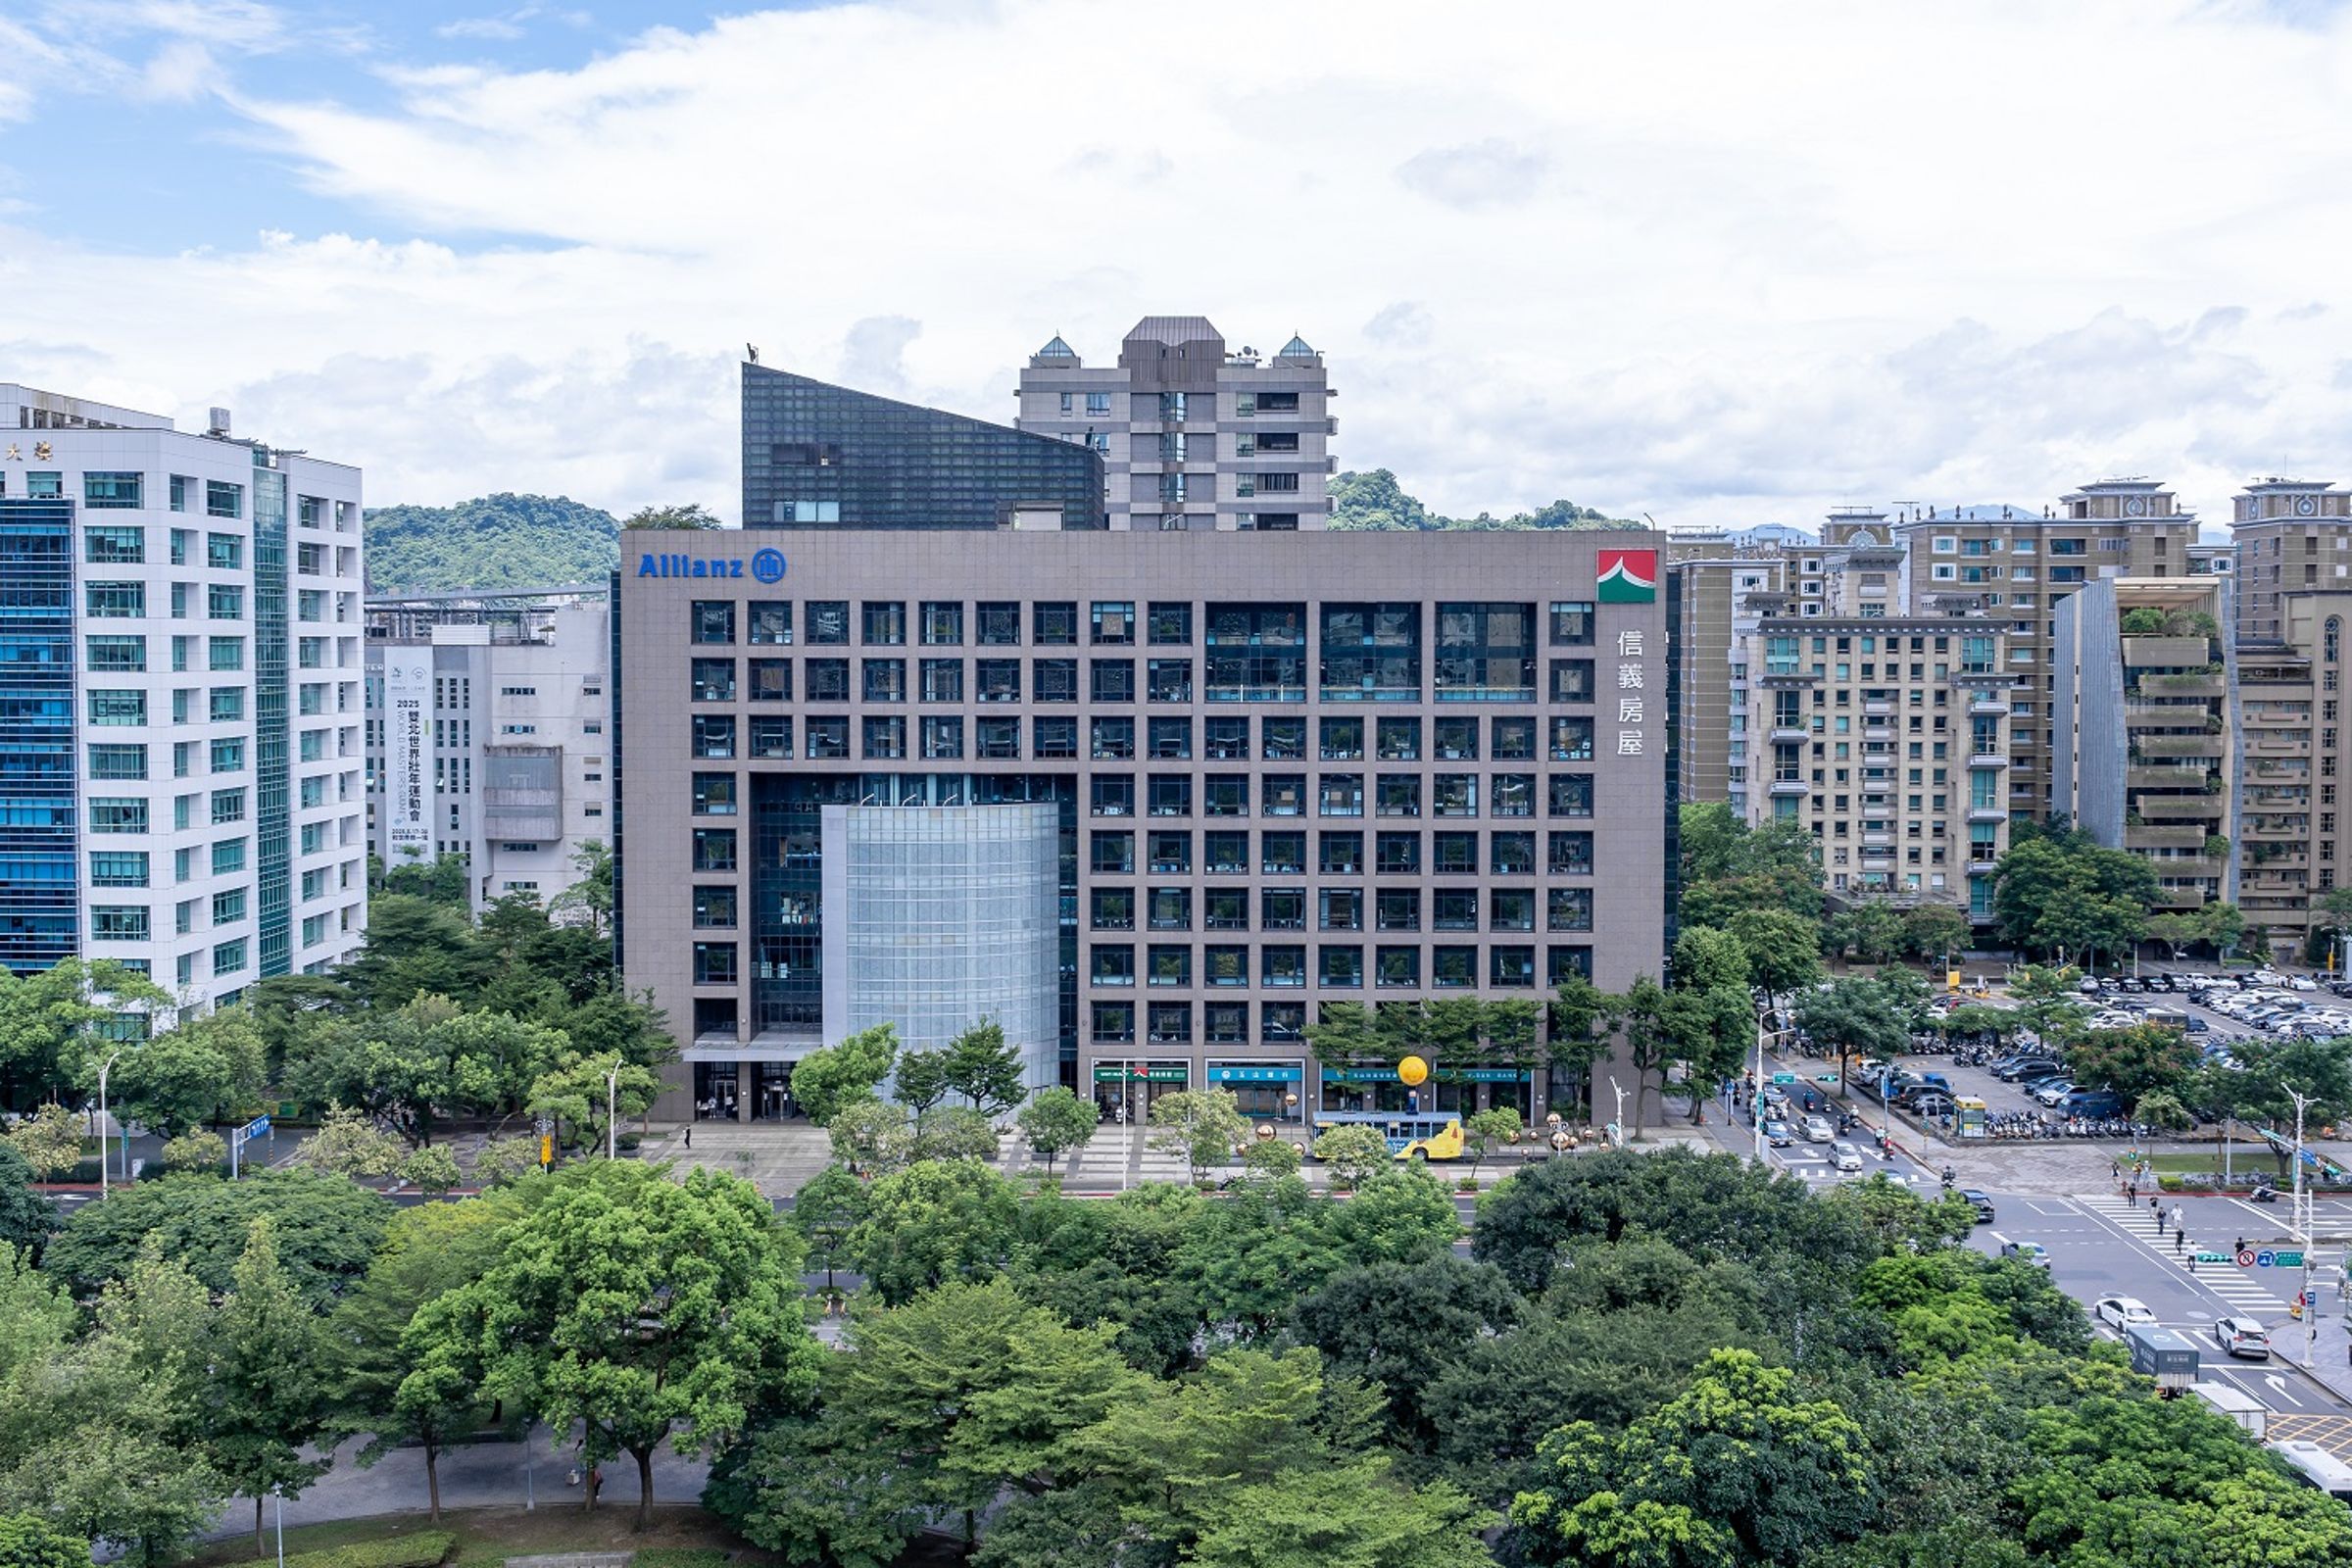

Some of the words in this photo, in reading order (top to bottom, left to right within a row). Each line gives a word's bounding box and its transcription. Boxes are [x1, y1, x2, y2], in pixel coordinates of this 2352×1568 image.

[638, 554, 744, 578] Allianz
[1617, 630, 1643, 756] 信義房屋
